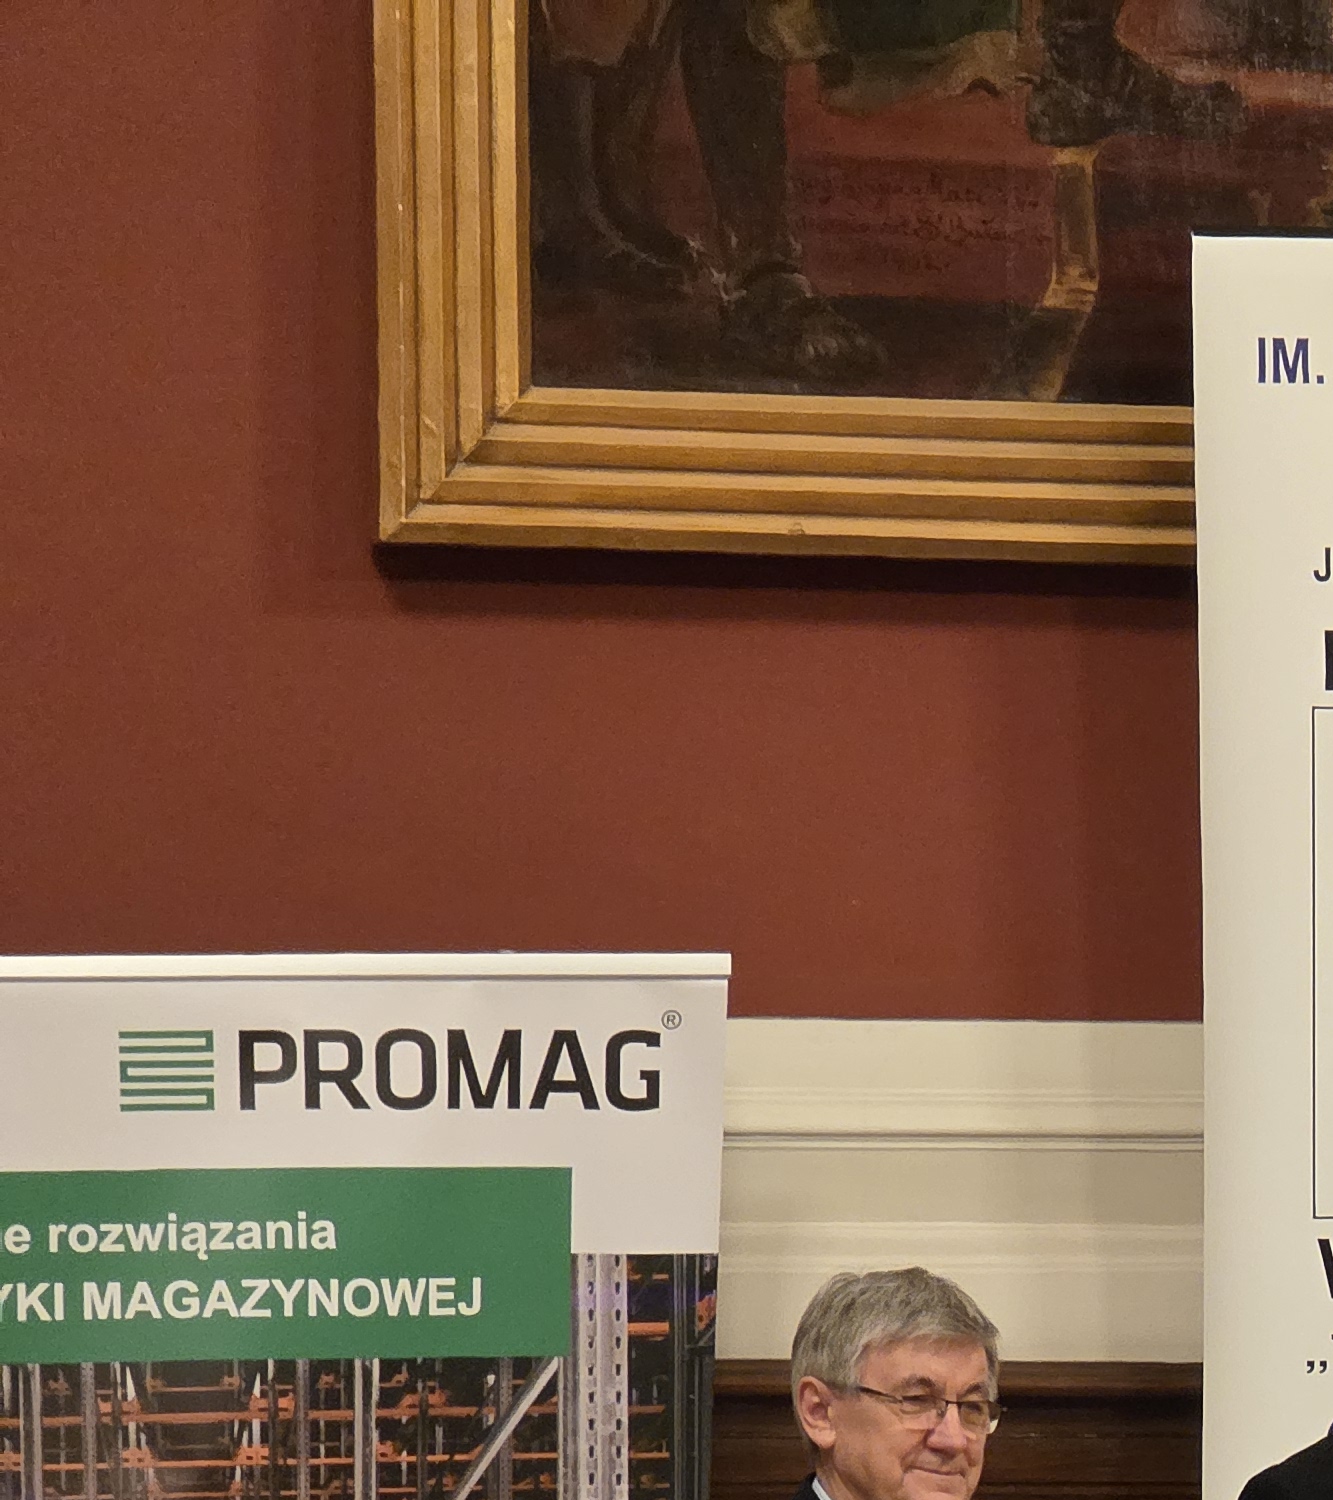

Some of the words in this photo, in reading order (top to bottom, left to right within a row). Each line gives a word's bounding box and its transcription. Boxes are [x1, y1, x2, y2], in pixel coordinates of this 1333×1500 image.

[1257, 337, 1325, 385] IM.
[238, 1028, 662, 1112] PROMAG
[48, 1210, 338, 1260] rozwiązania
[82, 1277, 483, 1321] MAGAZYNOWEJ
